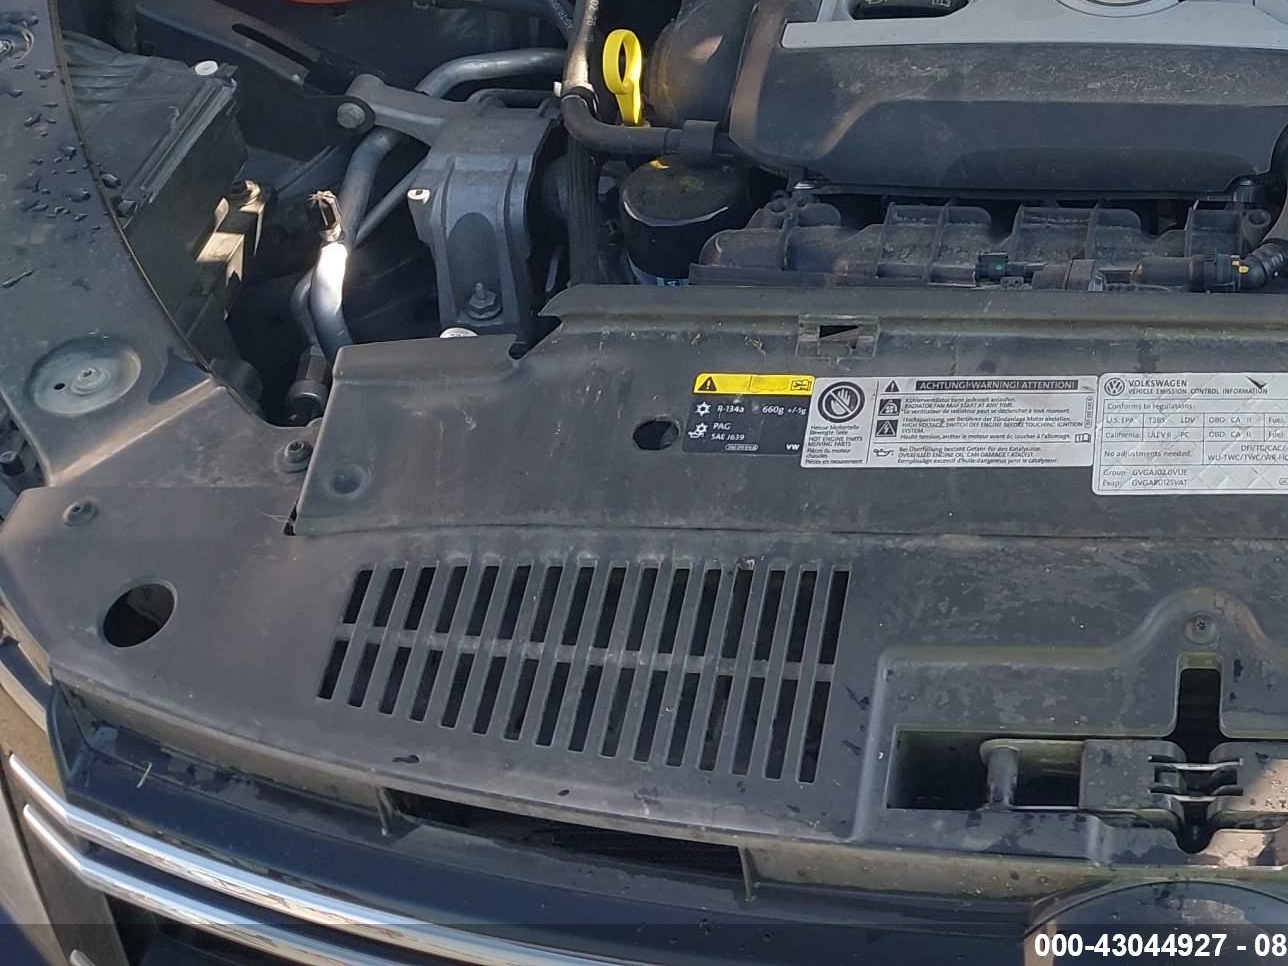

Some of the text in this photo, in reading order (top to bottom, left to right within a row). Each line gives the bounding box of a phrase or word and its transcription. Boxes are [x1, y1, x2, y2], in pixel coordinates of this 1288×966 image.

[1022, 381, 1075, 389] ATTENTION!
[1128, 379, 1187, 387] VOLKSWAGEN
[762, 405, 784, 415] 660g
[1107, 402, 1141, 410] Conforms
